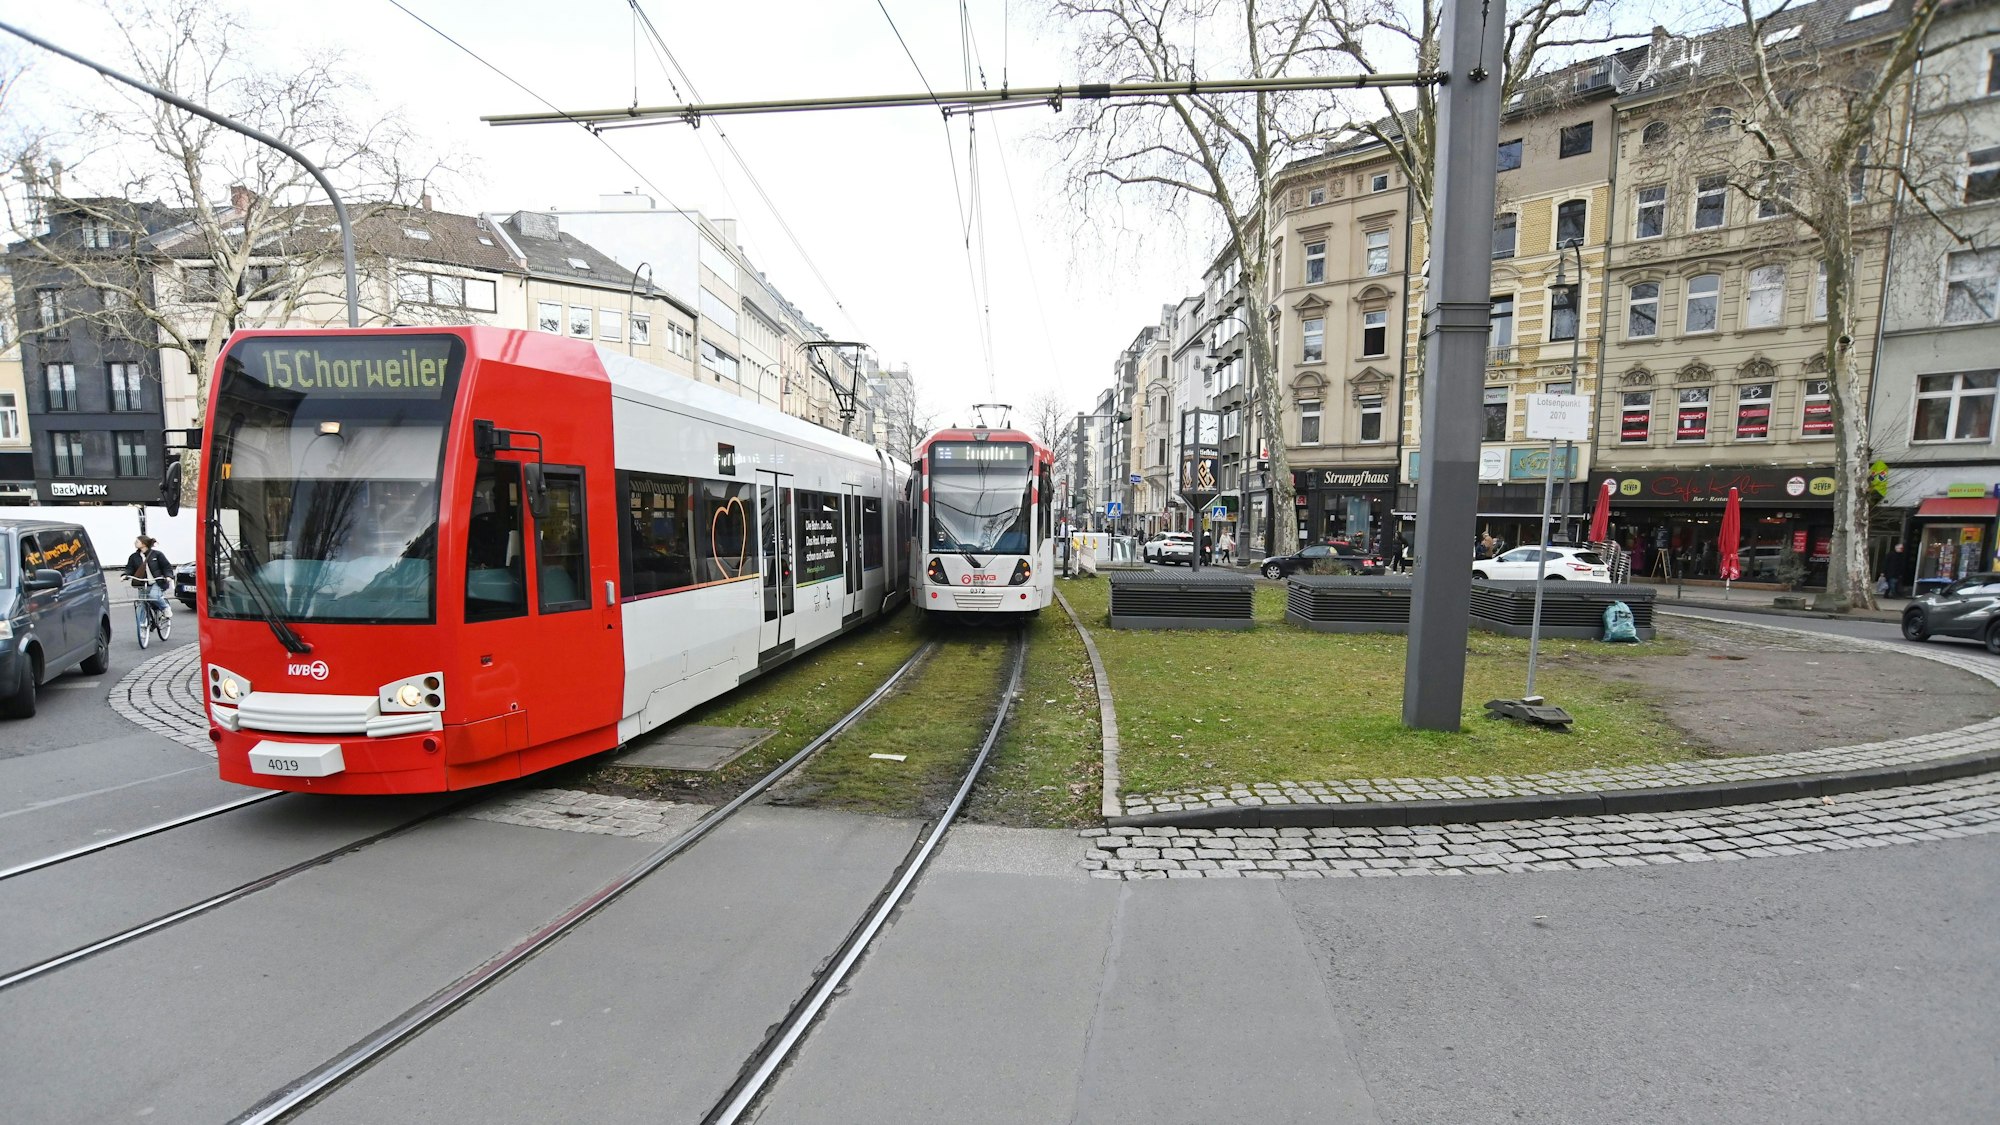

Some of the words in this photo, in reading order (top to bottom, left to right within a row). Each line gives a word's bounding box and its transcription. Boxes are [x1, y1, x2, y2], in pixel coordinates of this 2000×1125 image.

[1537, 398, 1581, 408] Lotsenpunkt
[1550, 411, 1566, 420] 2070
[1324, 471, 1390, 486] Strumpfhaus
[53, 484, 107, 496] backWERK
[1813, 482, 1832, 491] JEVER
[288, 663, 311, 676] KVB
[268, 759, 299, 771] 4019
